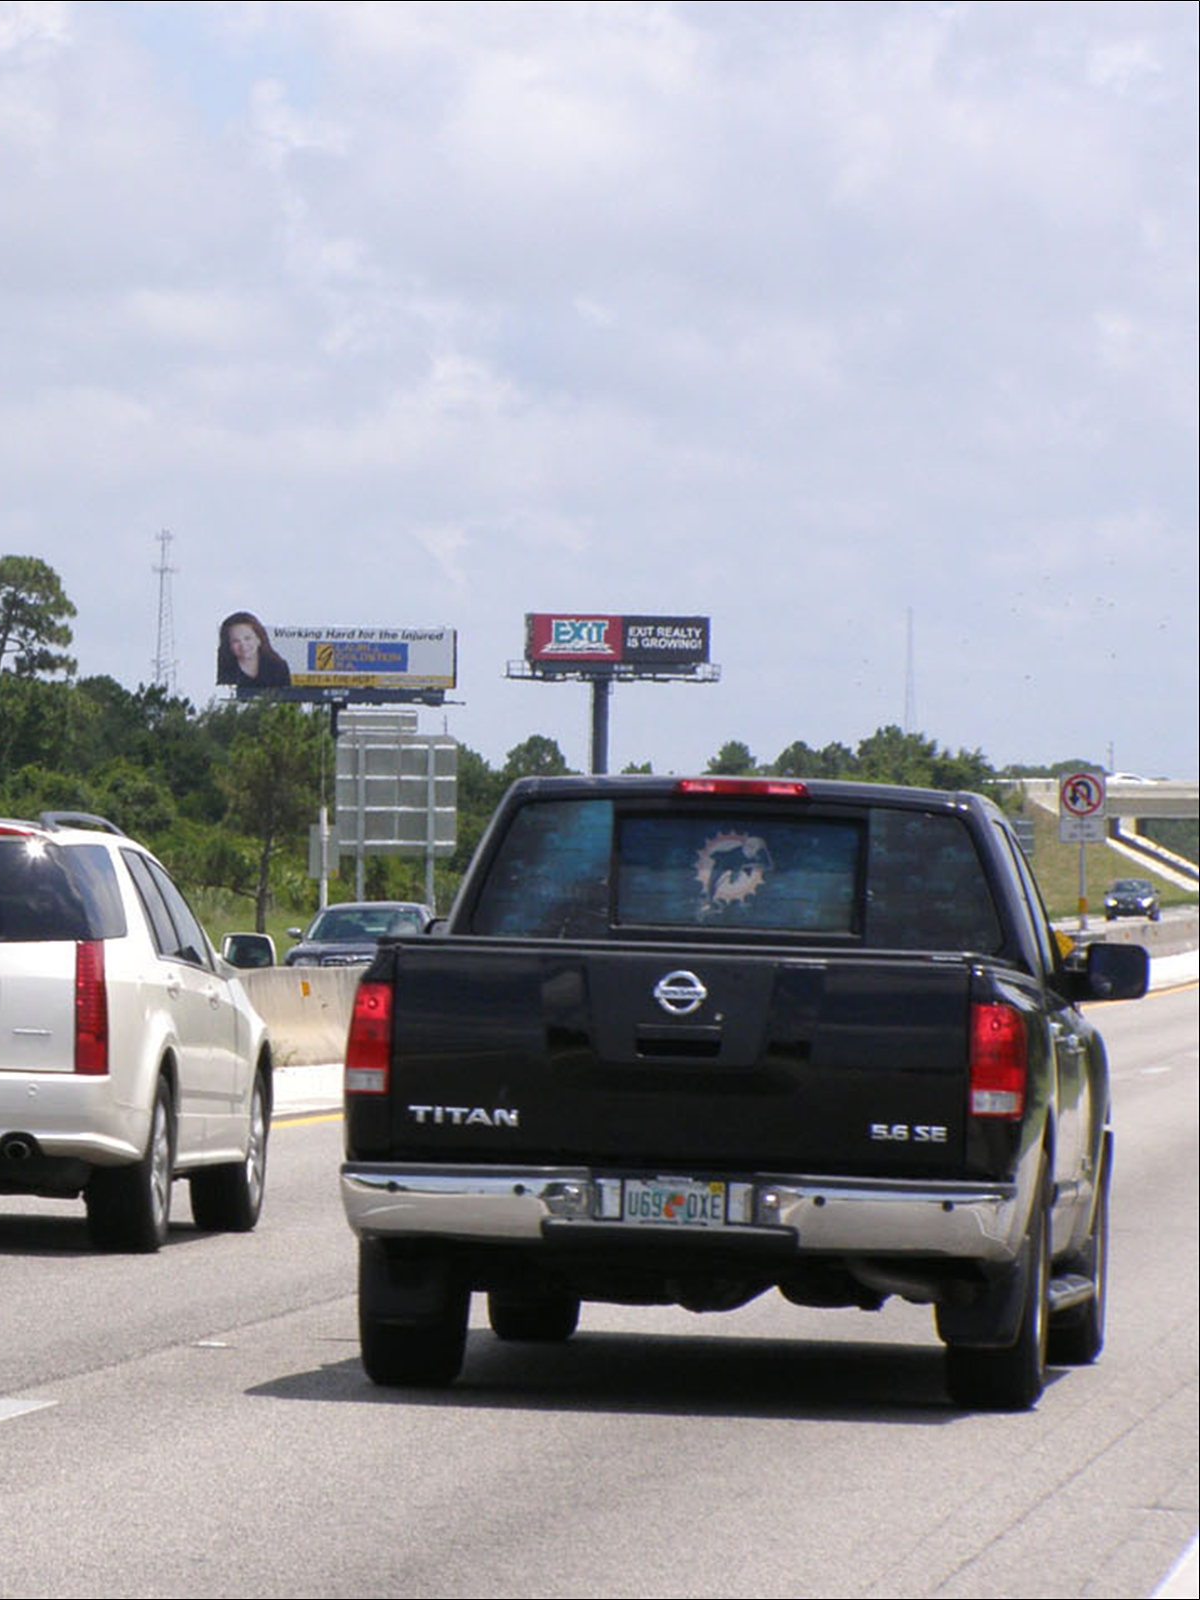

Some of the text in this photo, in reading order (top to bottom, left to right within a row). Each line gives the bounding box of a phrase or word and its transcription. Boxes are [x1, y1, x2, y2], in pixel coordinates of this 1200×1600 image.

[274, 628, 444, 641] Working Hard for the Injured
[553, 620, 608, 644] EXIT
[629, 626, 702, 639] EXIT REALTY
[627, 637, 702, 649] IS GROWING!
[408, 1105, 519, 1126] TITAN
[871, 1124, 947, 1142] 5.6 SE
